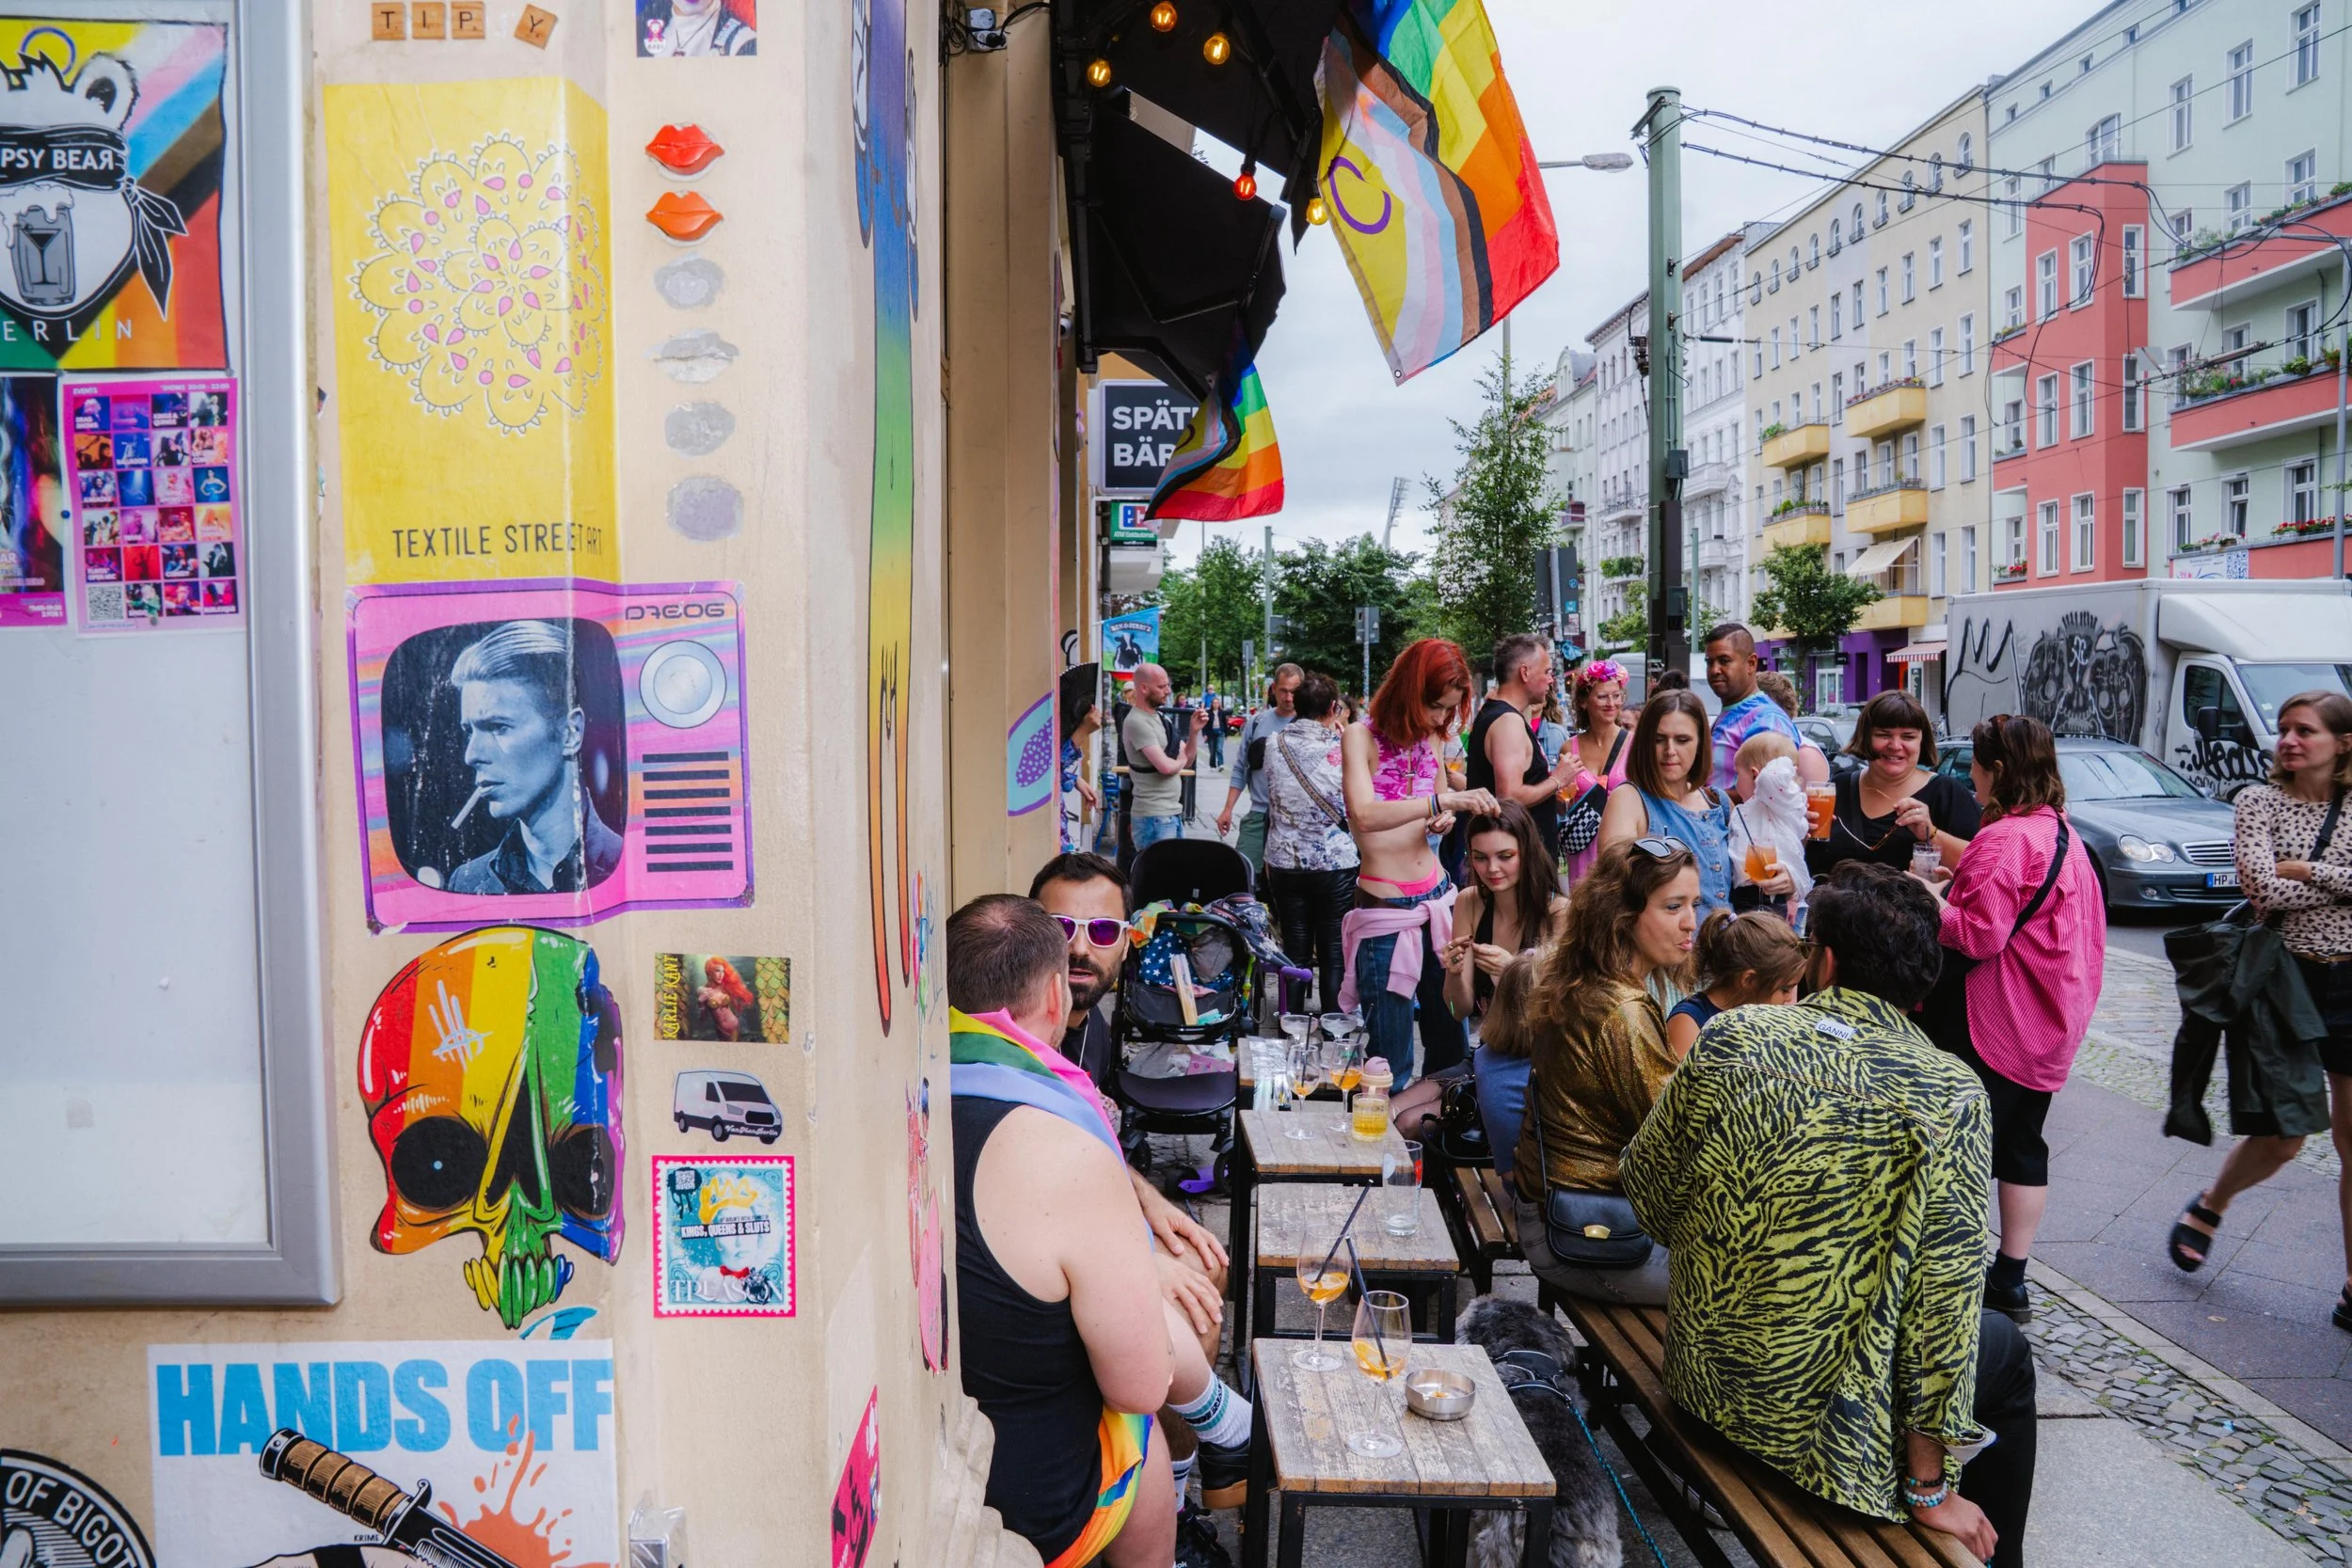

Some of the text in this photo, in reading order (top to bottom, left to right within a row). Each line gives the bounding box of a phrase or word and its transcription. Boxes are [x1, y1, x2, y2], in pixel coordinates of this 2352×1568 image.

[391, 522, 602, 558] TEXTILE STREET ART
[2214, 874, 2228, 885] HP
[662, 954, 681, 1040] KARLIE KANT
[1818, 1023, 1850, 1039] GANNI
[681, 1221, 770, 1238] KINGS, QUEENS & SLUTS
[156, 1358, 612, 1456] HANDS OFF
[6, 1469, 58, 1509] OF
